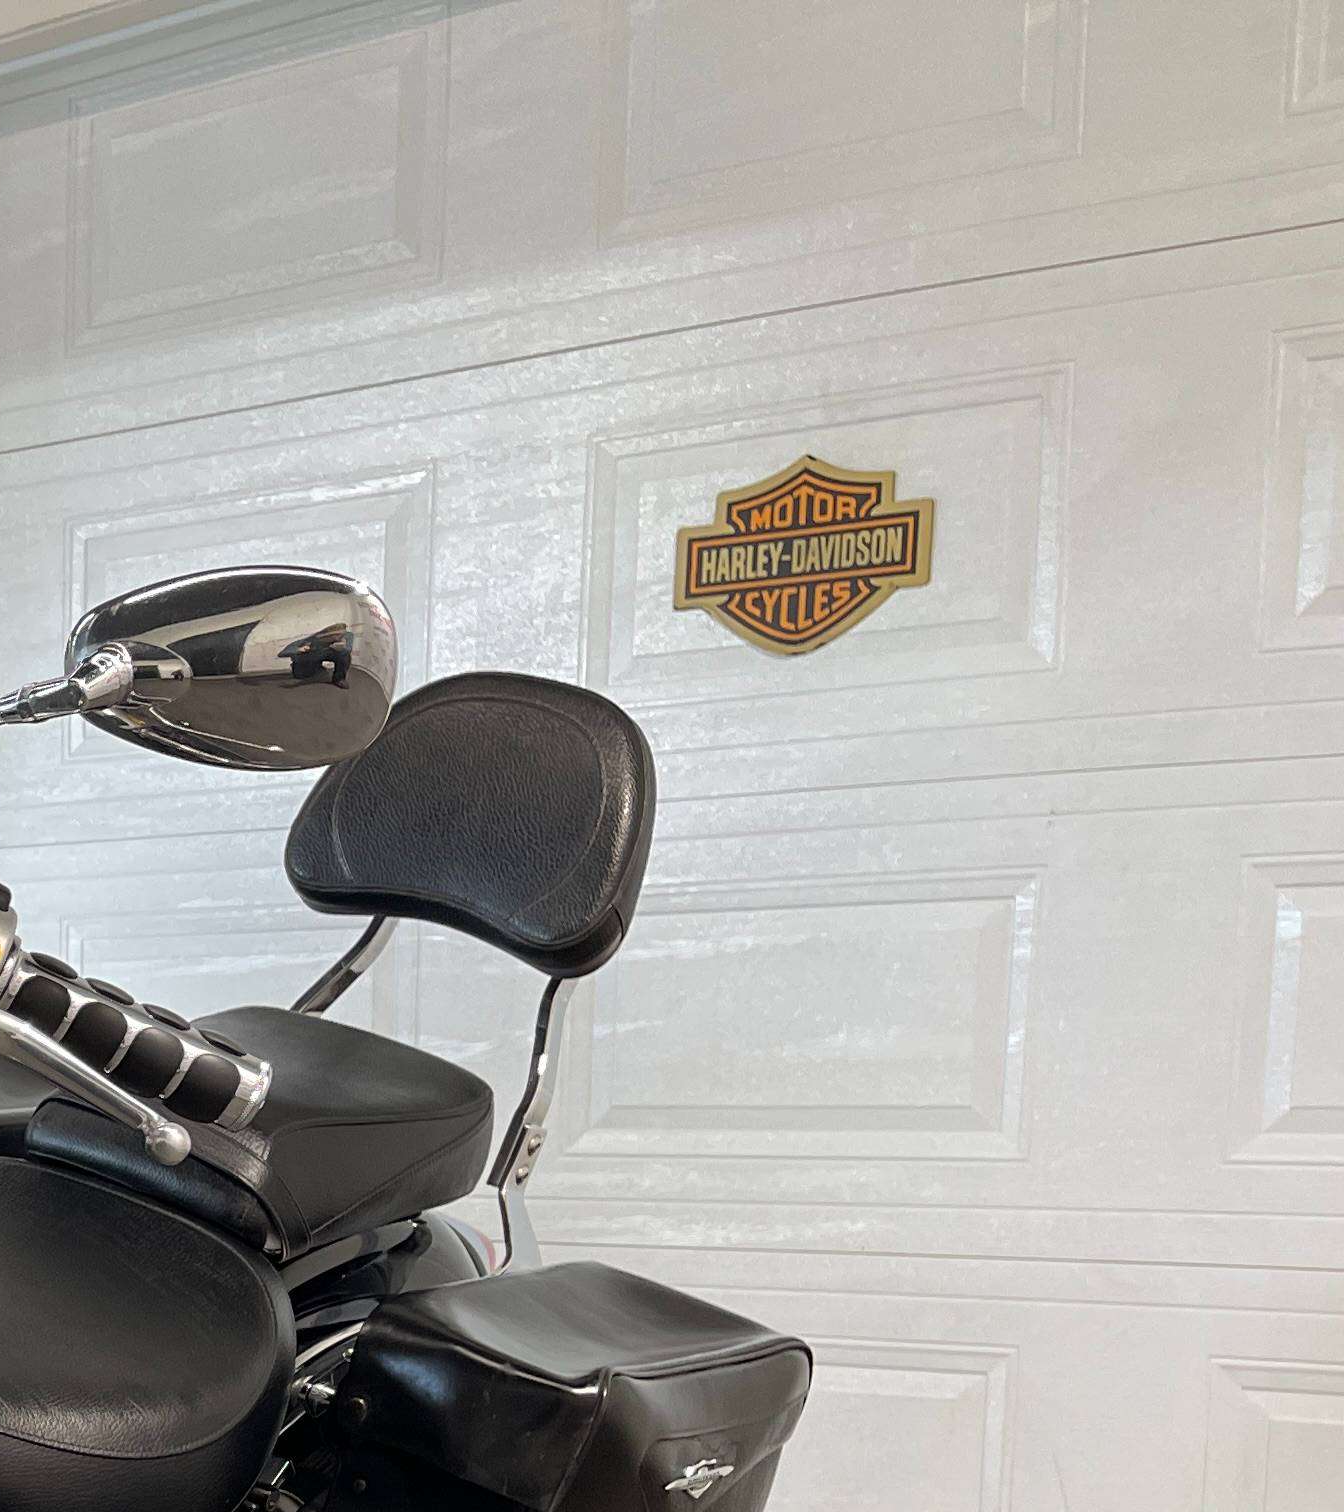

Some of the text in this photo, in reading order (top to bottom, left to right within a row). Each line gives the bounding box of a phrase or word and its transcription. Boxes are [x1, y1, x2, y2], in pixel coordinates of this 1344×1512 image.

[749, 484, 856, 531] MOTOR
[700, 526, 904, 585] HARLEY-DAVIDSON
[744, 580, 852, 631] CYCLES
